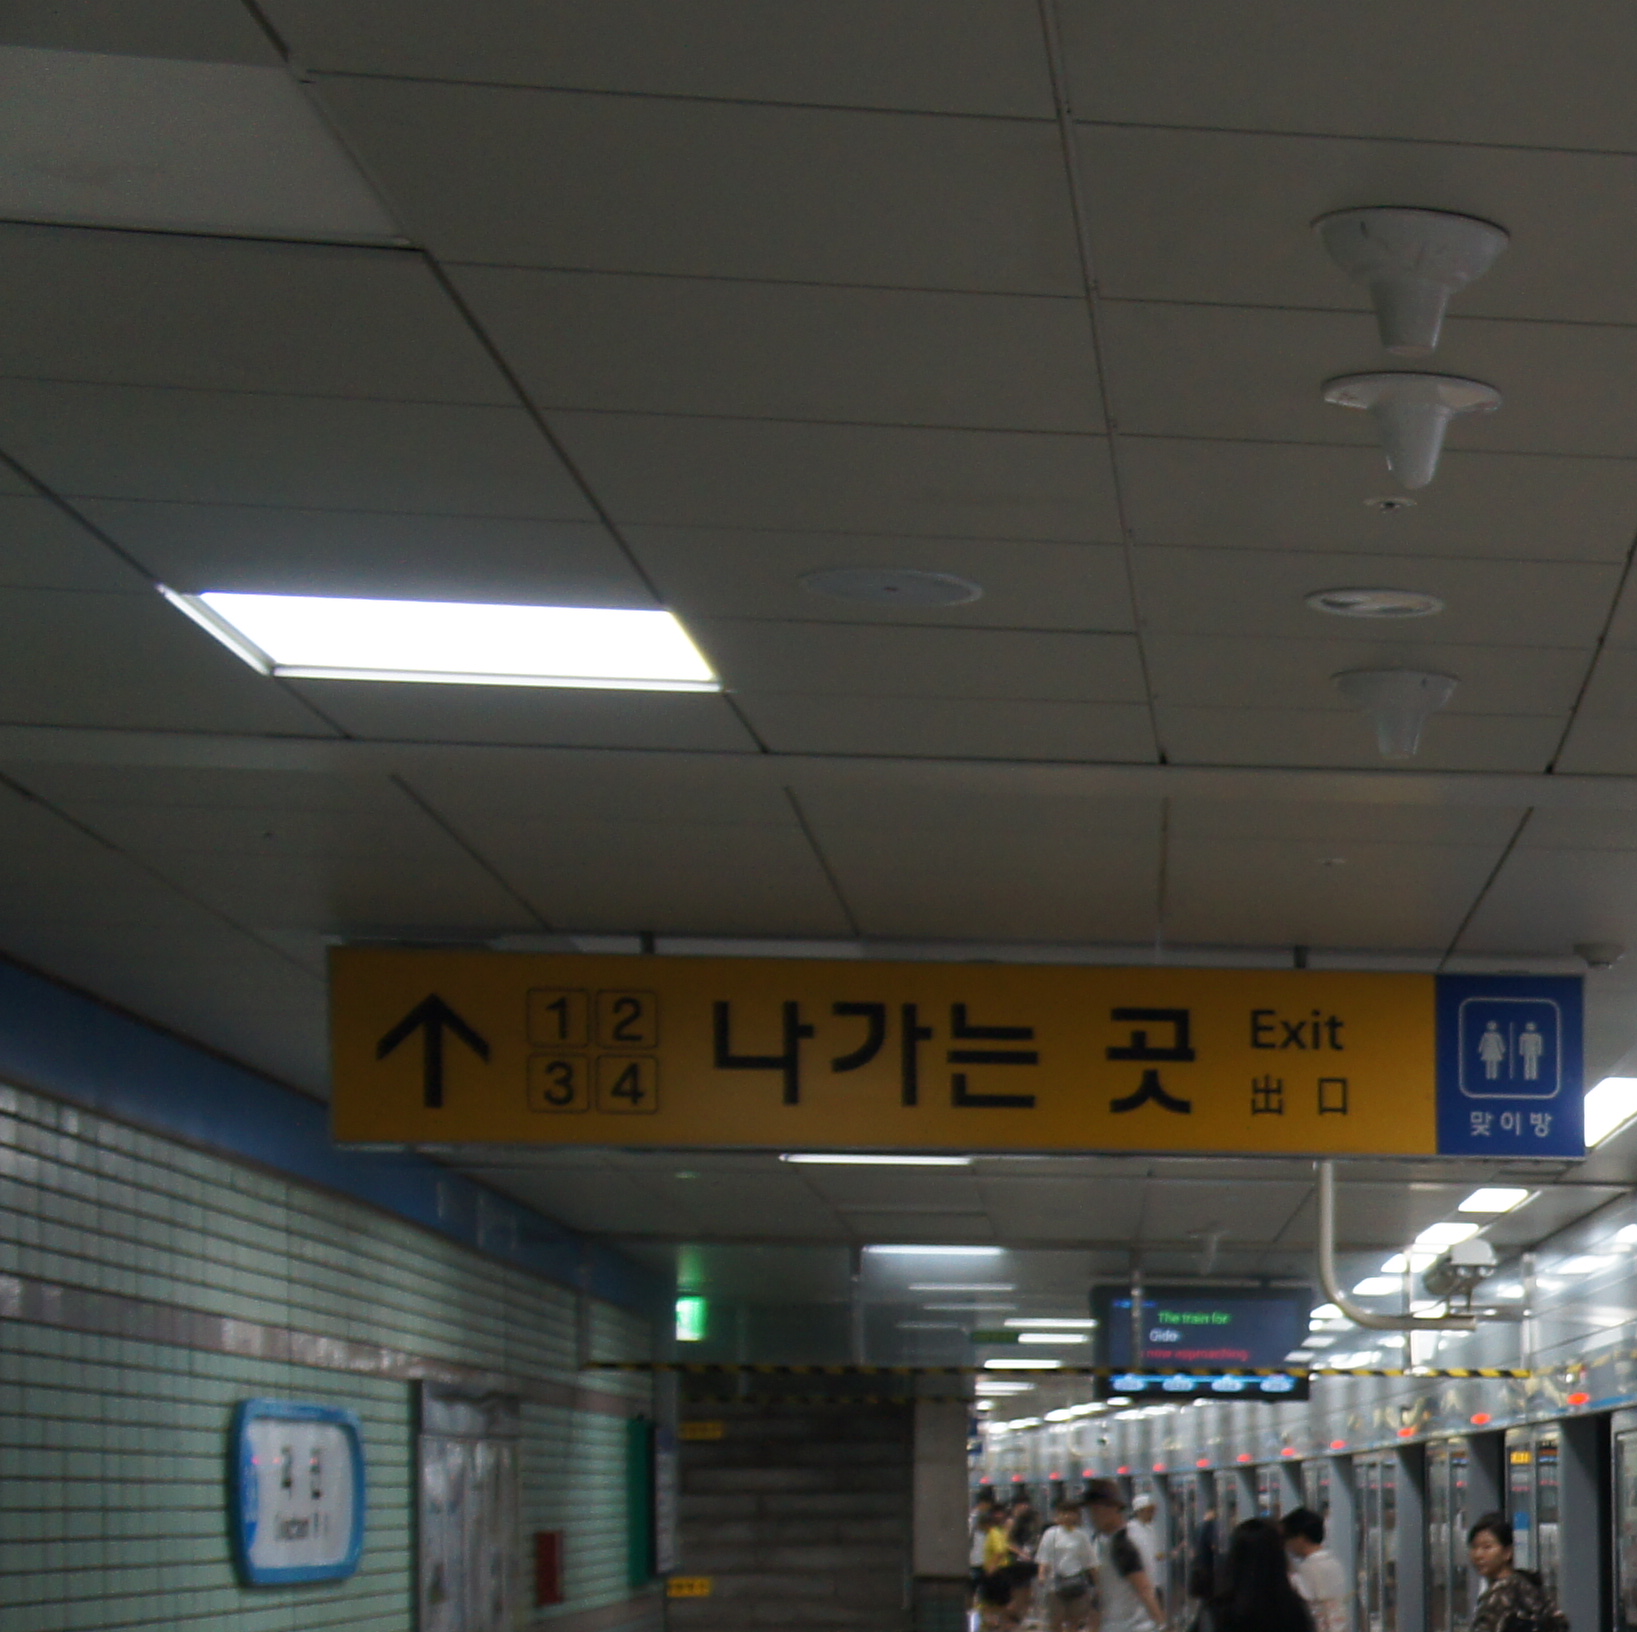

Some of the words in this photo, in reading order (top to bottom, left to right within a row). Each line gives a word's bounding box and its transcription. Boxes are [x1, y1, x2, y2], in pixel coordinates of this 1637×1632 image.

[545, 996, 568, 1041] 1
[611, 996, 643, 1042] 2
[1250, 1009, 1345, 1050] Exit
[712, 1000, 1038, 1110] 나가는
[1105, 1007, 1196, 1114] 곳
[543, 1060, 576, 1106] 3
[610, 1061, 645, 1105] 4
[1251, 1074, 1348, 1115] 出口
[1470, 1111, 1552, 1137] 맞이방
